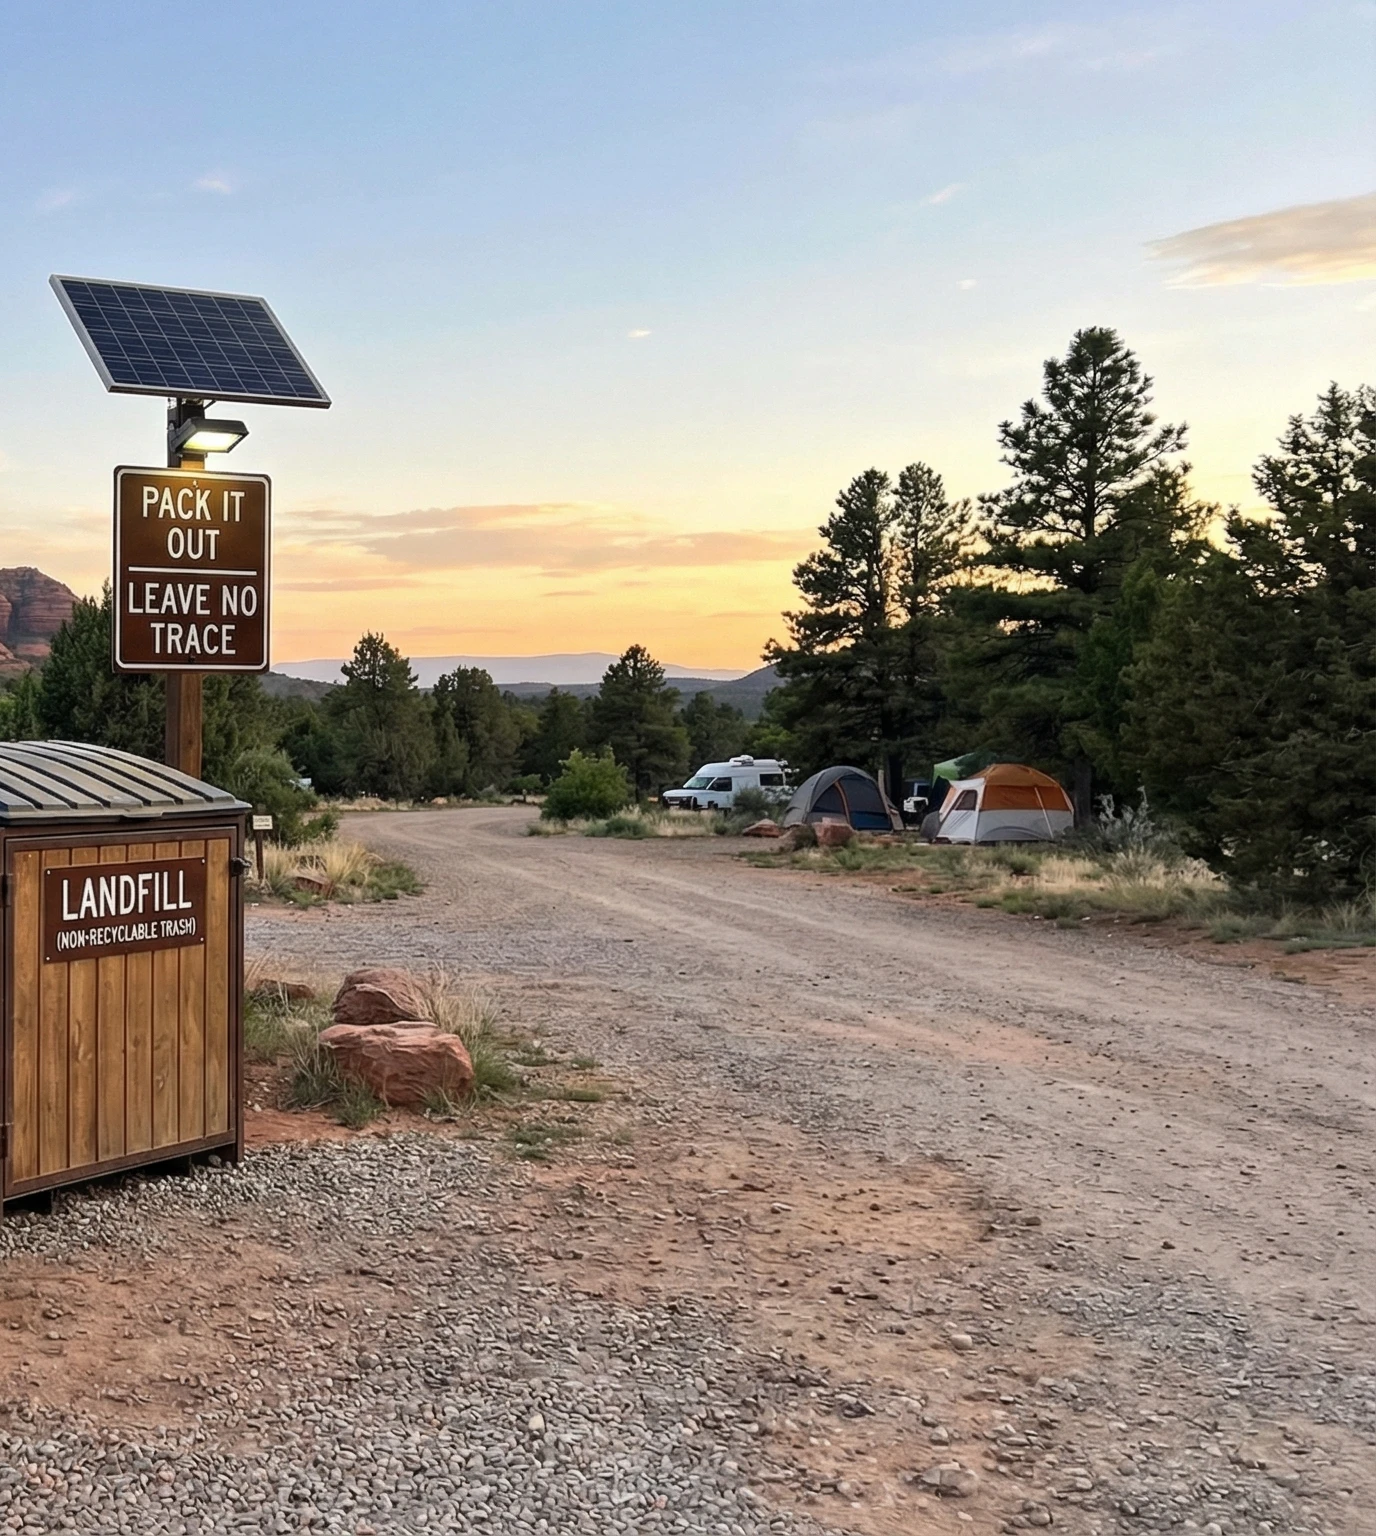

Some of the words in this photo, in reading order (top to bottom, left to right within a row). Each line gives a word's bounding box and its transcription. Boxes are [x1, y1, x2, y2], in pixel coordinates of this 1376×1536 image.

[142, 485, 211, 521] PACK
[223, 491, 245, 522] IT
[167, 527, 220, 560] OUT
[128, 582, 211, 615] LEAVE
[222, 585, 257, 617] NO
[150, 622, 236, 655] TRACE
[62, 870, 193, 922] LANDFILL
[56, 921, 158, 952] (NON-RECYCLABLE
[160, 916, 197, 938] TRASH)
